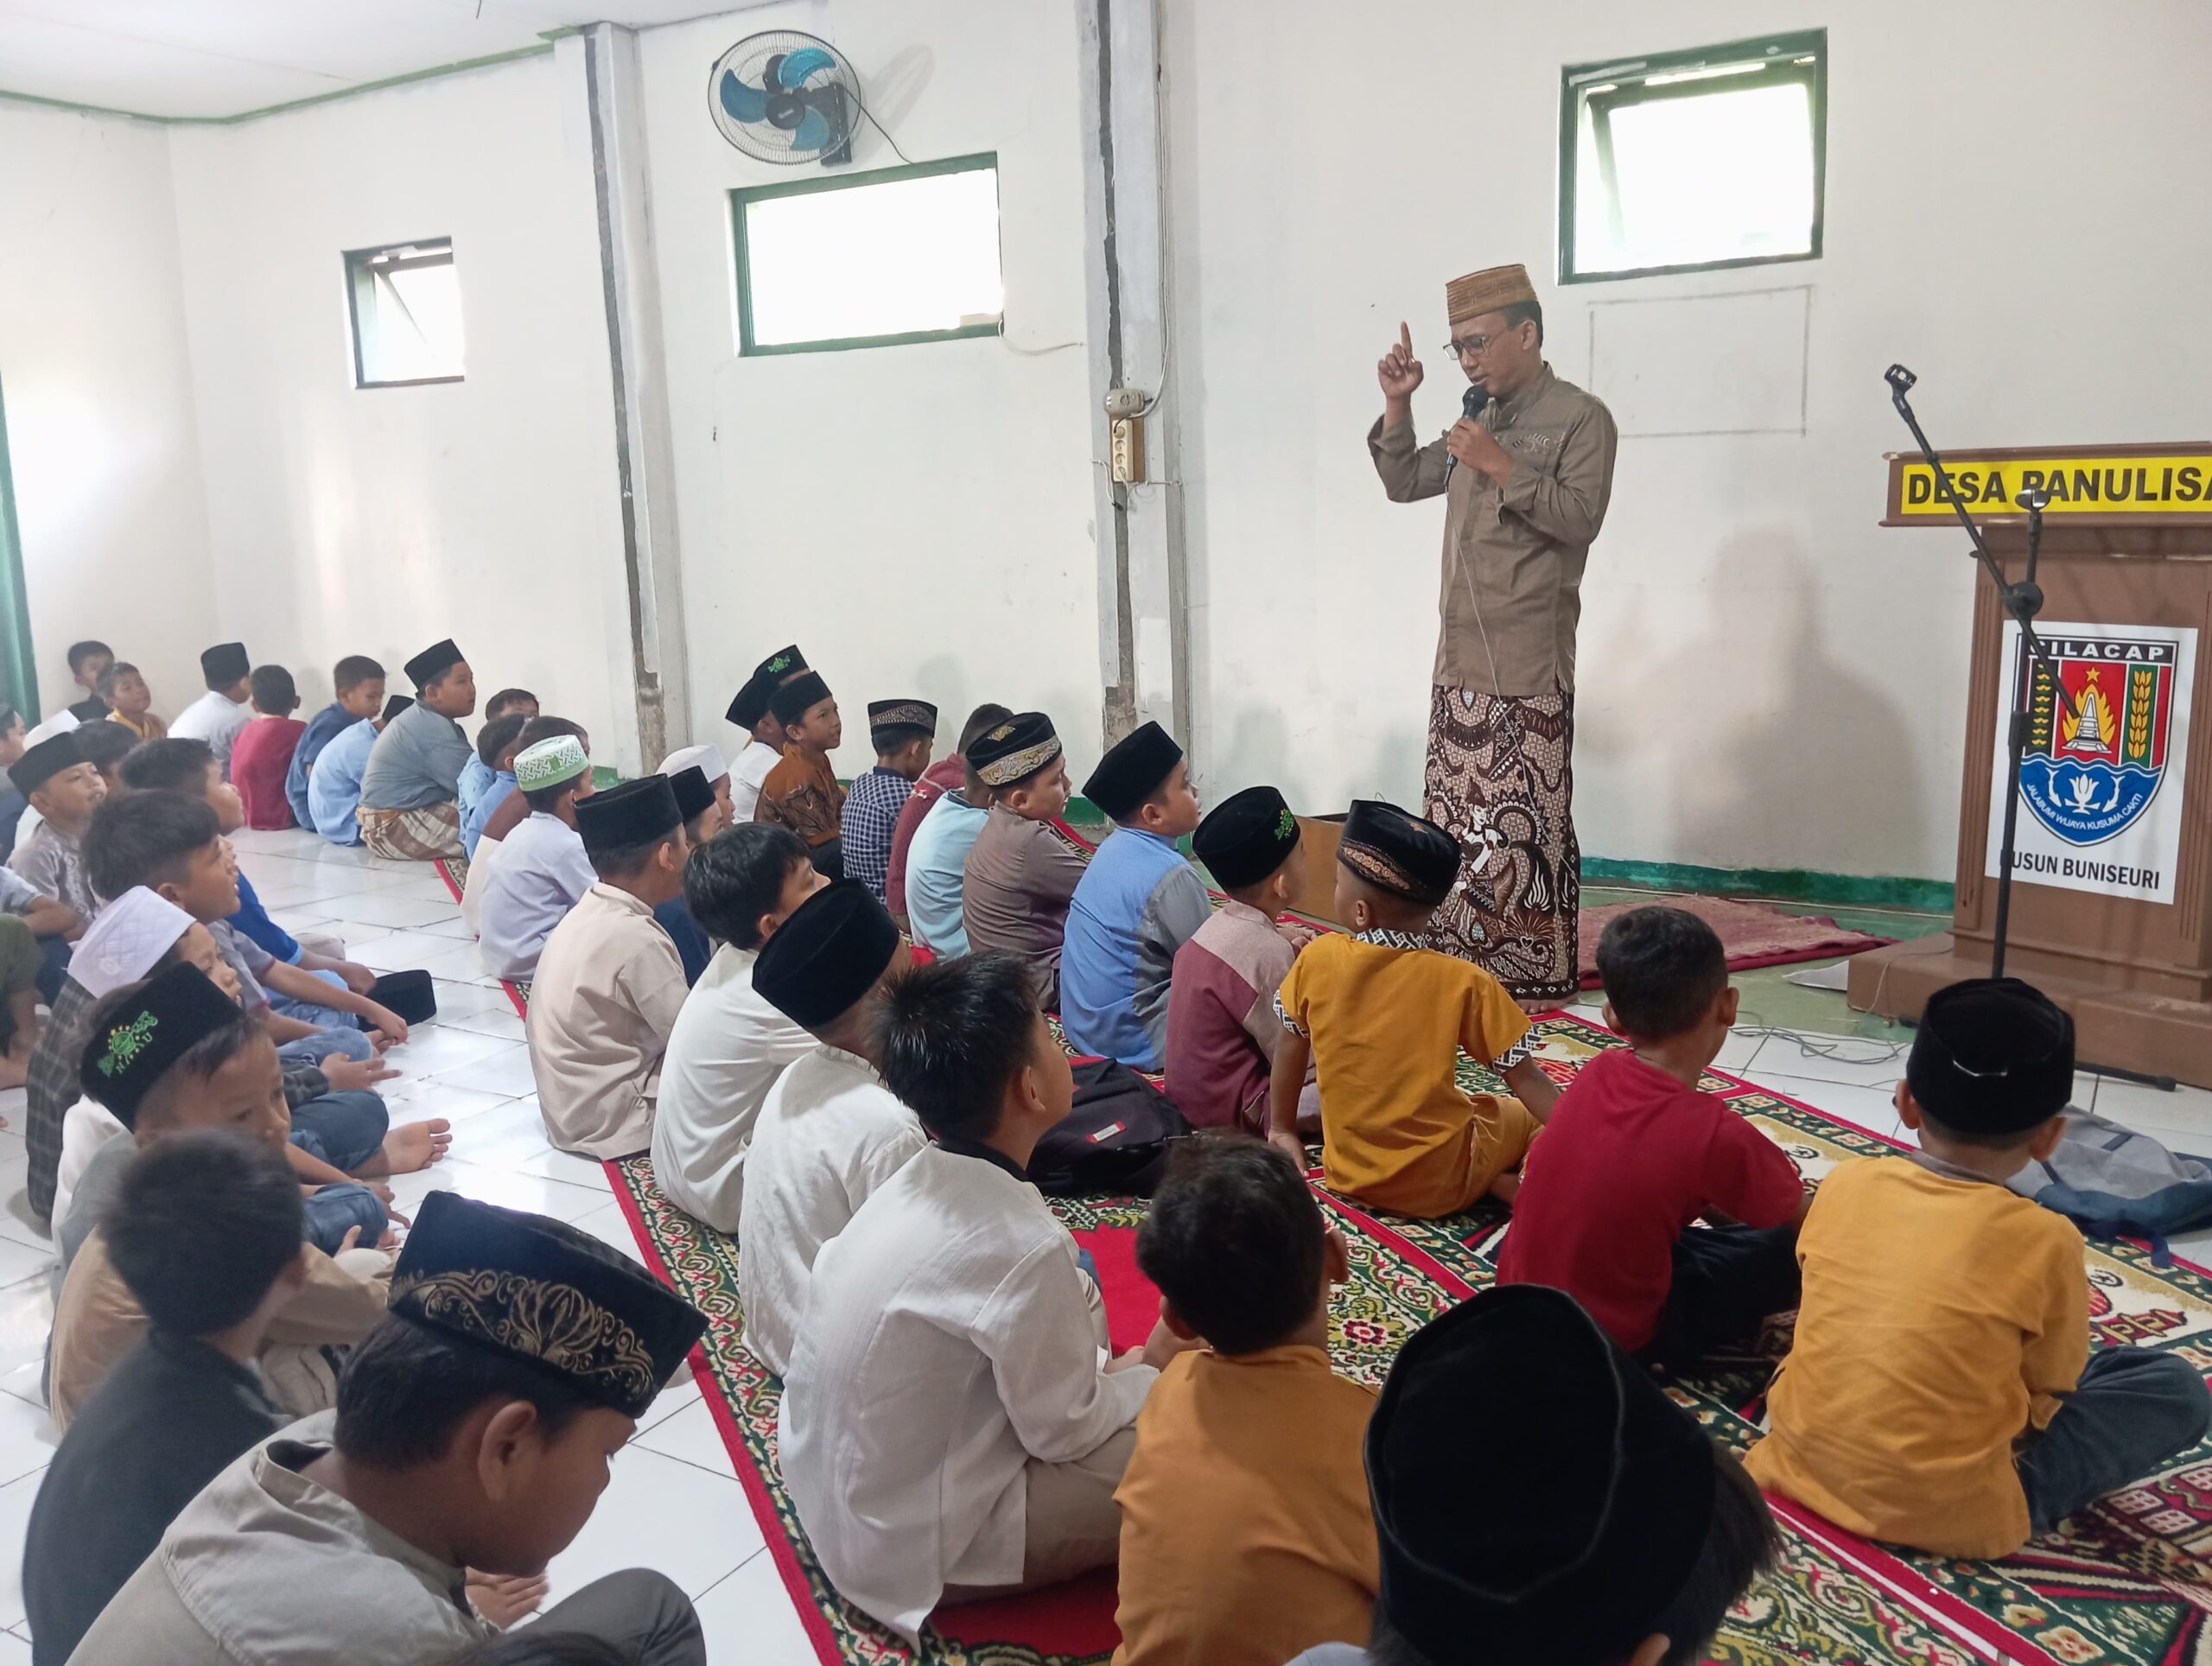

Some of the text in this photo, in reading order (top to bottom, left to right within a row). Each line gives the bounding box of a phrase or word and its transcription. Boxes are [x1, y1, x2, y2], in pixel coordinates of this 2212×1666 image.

[1909, 472, 2007, 504] DESA
[2030, 639, 2164, 661] ILACAP
[2026, 784, 2144, 830] JALABUMI WIJAYA KUSUMA CAKTI
[2001, 850, 2160, 890] USUN BUNISEURI
